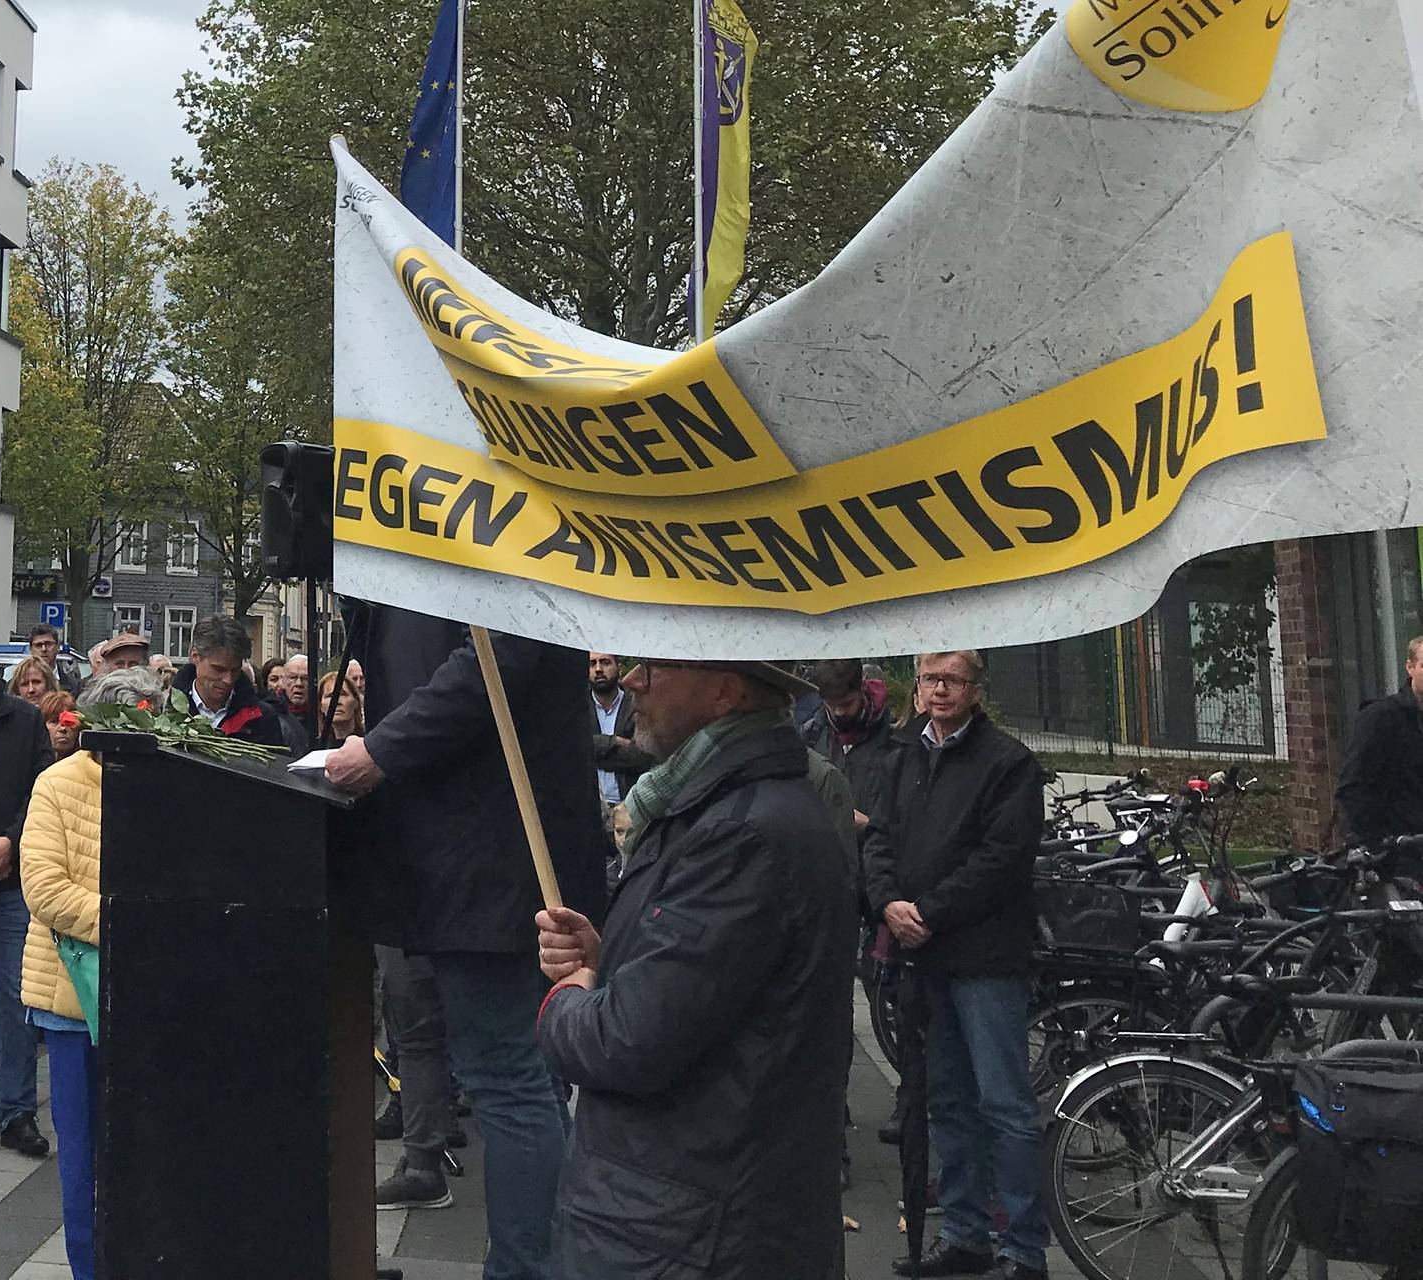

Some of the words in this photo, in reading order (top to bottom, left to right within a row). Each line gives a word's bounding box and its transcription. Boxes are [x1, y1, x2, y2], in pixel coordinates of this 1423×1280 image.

[335, 448, 528, 547] EGEN
[523, 294, 1264, 593] ANTISEMITISMUS!
[457, 379, 757, 476] SOLINGEN
[46, 605, 59, 624] P
